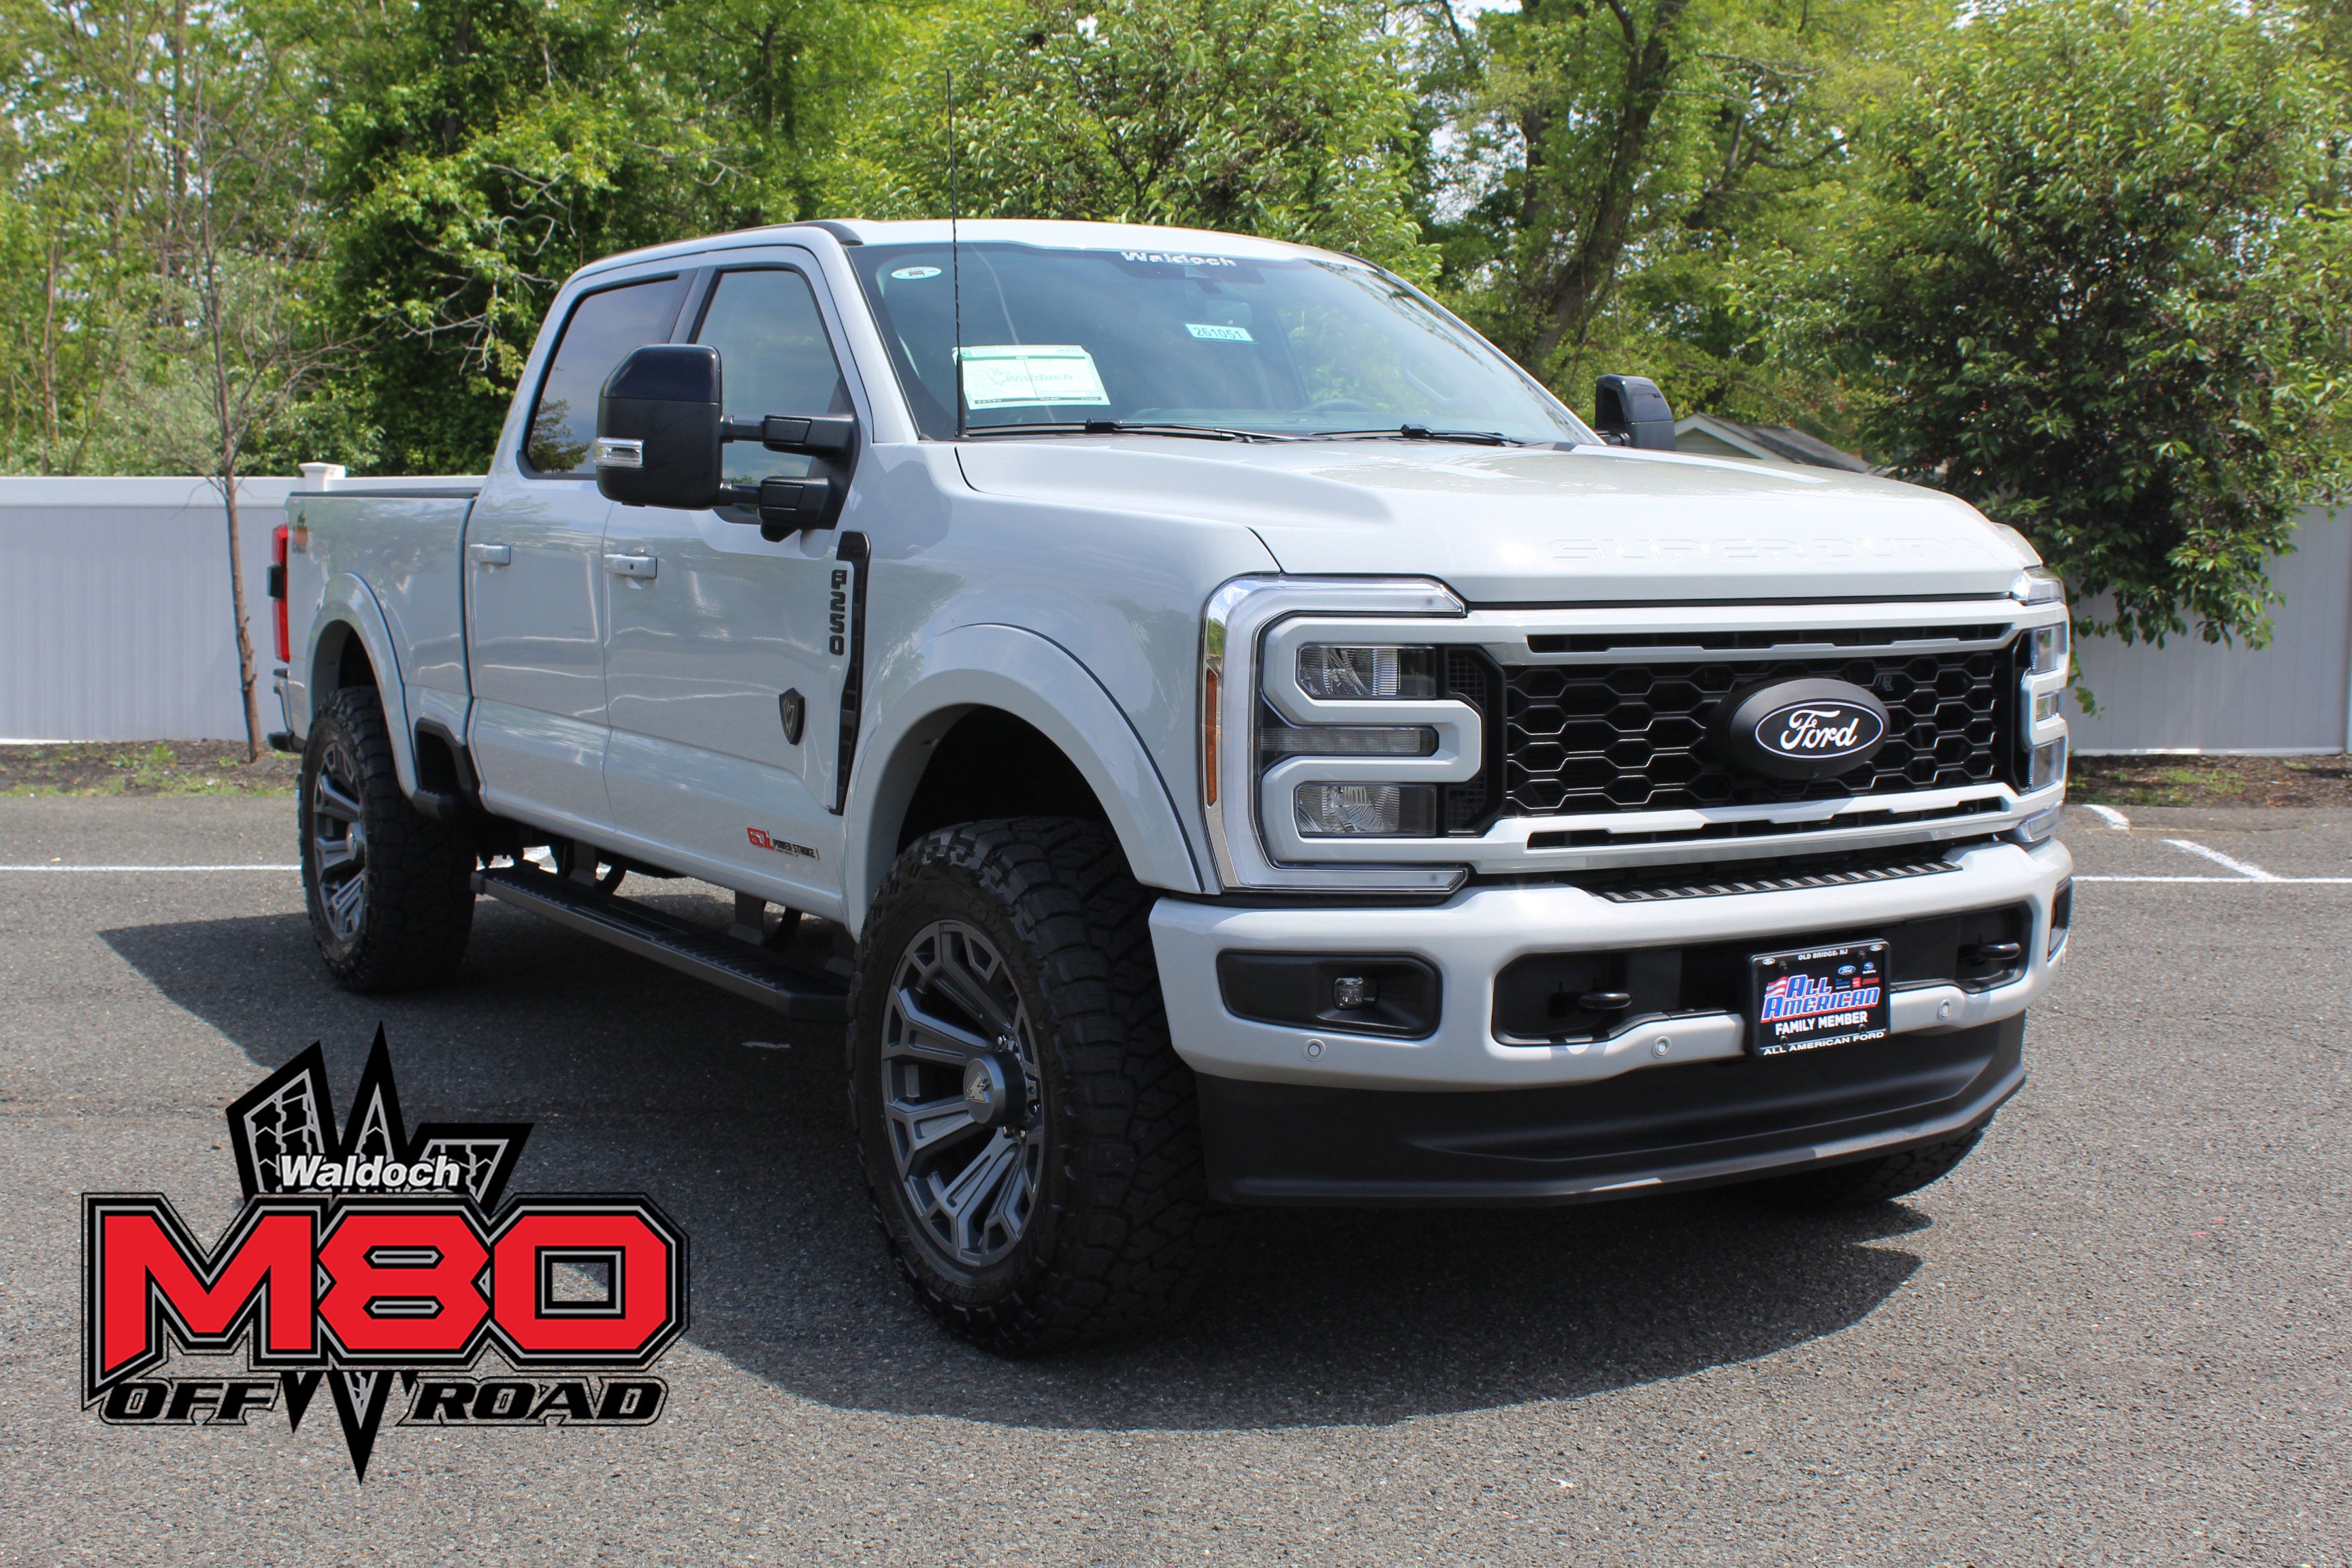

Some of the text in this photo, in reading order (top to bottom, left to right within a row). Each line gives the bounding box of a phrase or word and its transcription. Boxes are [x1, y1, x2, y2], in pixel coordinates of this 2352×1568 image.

[1121, 252, 1237, 267] Waldoch
[1193, 327, 1243, 340] 261051
[829, 569, 847, 656] F250
[1780, 708, 1860, 750] Ford
[791, 843, 816, 858] STROKE
[1775, 1011, 1868, 1036] FAMILY MEMBER
[1763, 1031, 1884, 1056] ALL AMERICAN FORD
